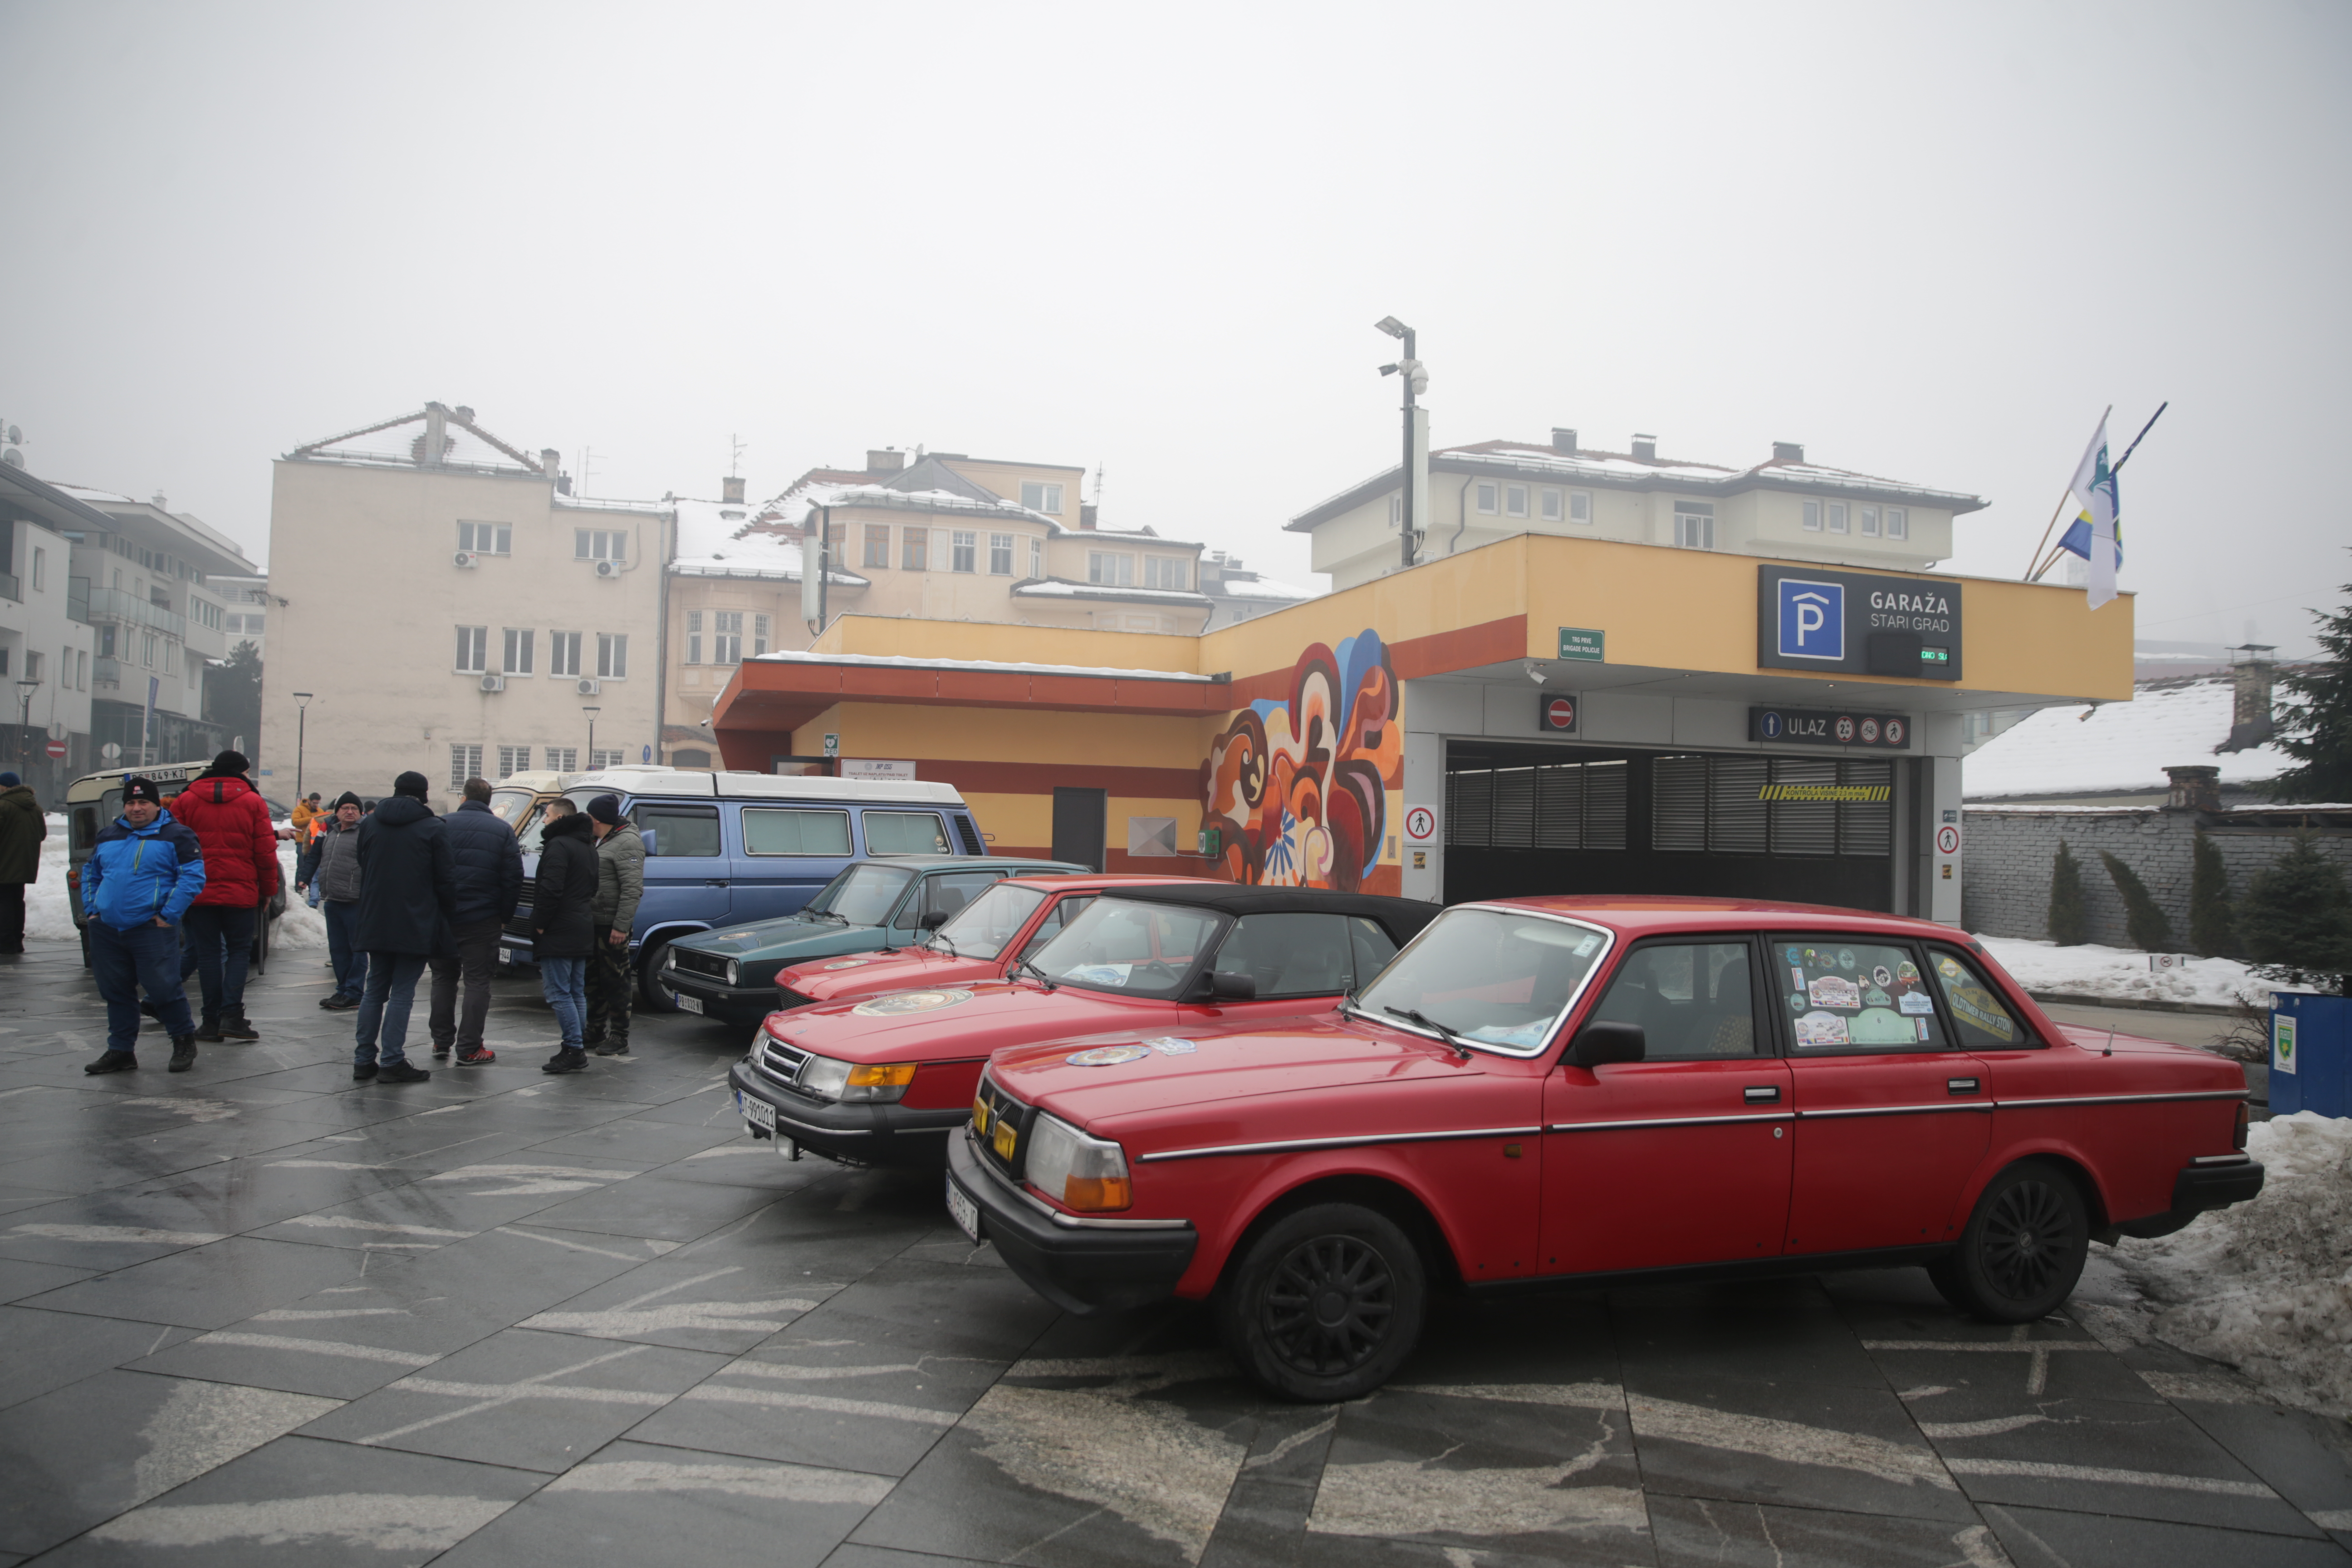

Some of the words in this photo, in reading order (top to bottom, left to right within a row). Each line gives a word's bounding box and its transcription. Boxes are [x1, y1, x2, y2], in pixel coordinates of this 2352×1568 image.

[1871, 591, 1949, 615] GARAŽA
[1798, 603, 1824, 646] P
[1871, 613, 1909, 629] STARI
[1912, 617, 1950, 632] GRAD
[1788, 718, 1826, 735] ULAZ
[151, 769, 184, 780] 849-KZ
[1952, 993, 1978, 1018] OLDTIMER
[1979, 1010, 1996, 1026] RALLY
[1996, 1015, 2011, 1033] STON
